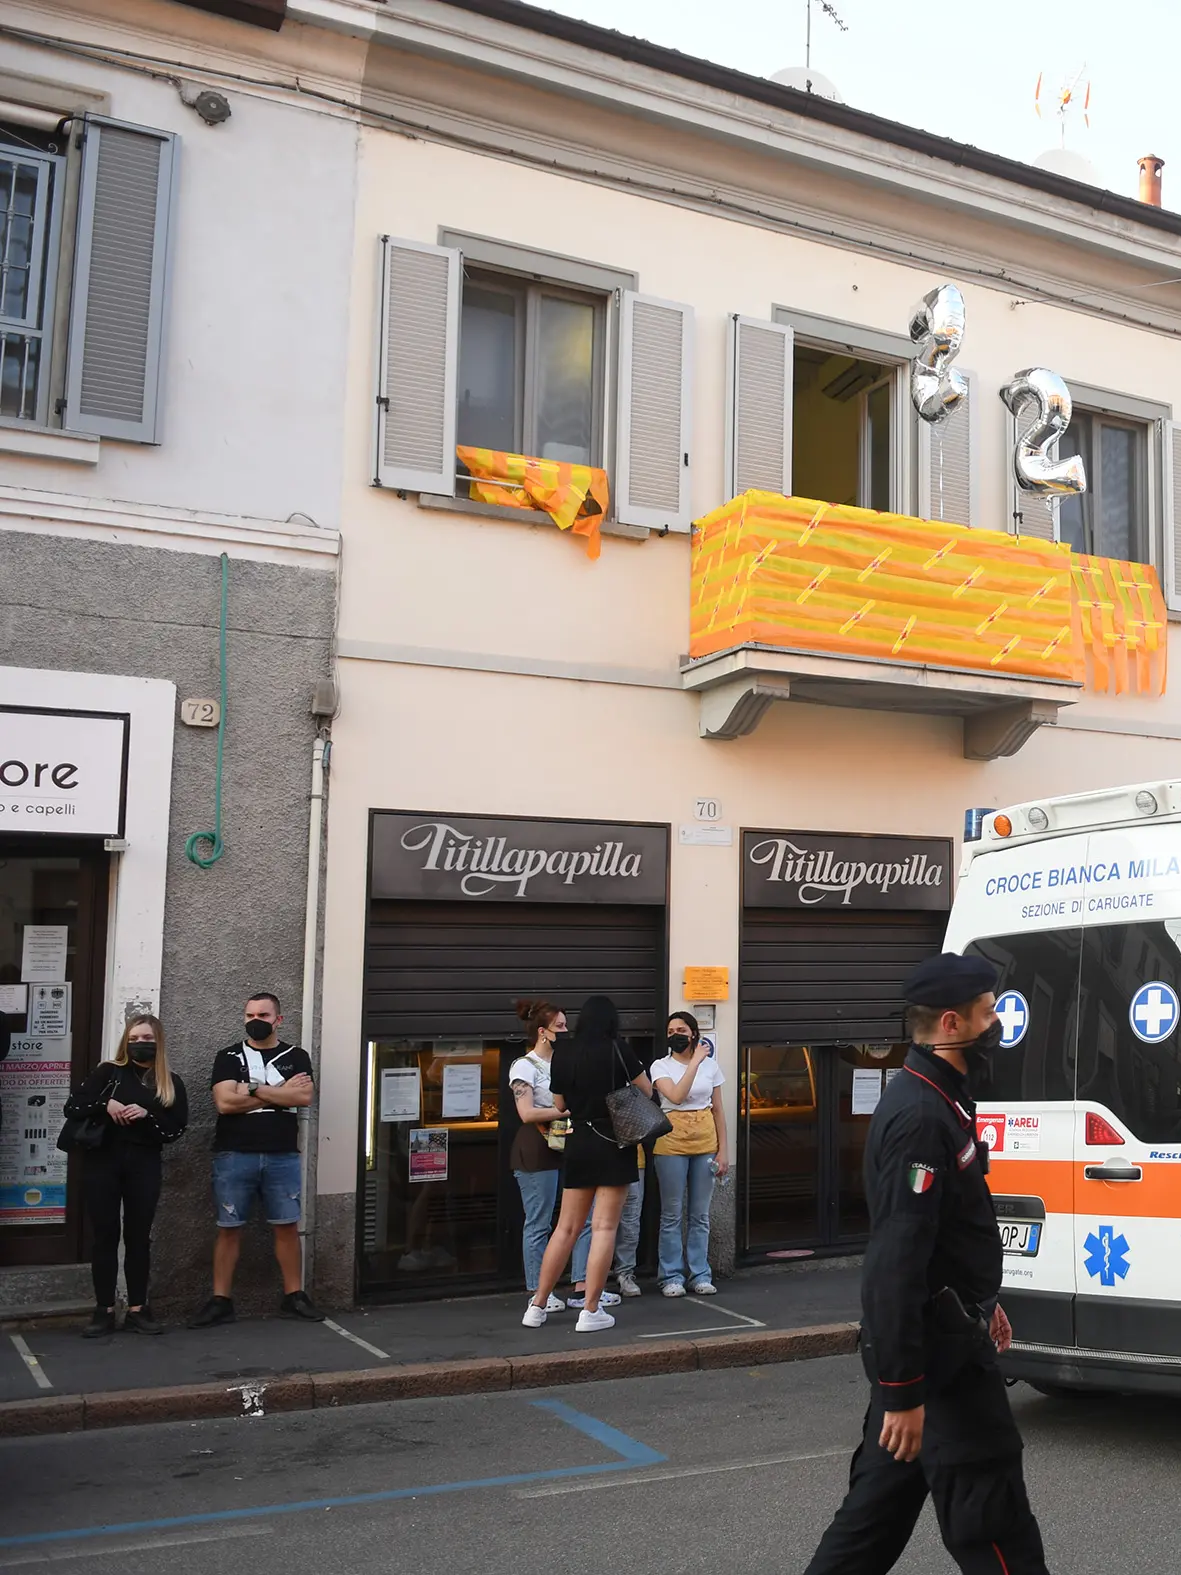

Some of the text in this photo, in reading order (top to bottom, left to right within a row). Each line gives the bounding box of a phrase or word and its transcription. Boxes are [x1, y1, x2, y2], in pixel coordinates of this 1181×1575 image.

[187, 703, 214, 722] 72
[11, 804, 20, 813] e
[25, 803, 76, 815] capelli
[697, 801, 717, 818] 70
[400, 822, 643, 897] Titillapapilla
[750, 838, 943, 905] Titillapapilla
[985, 871, 1043, 896] CROCE
[1047, 862, 1121, 888] BIANCA
[1021, 893, 1154, 919] SEZIONE DI CARUGATE
[12, 1040, 44, 1051] store
[1013, 1117, 1039, 1128] AREU
[985, 1133, 995, 1141] 112
